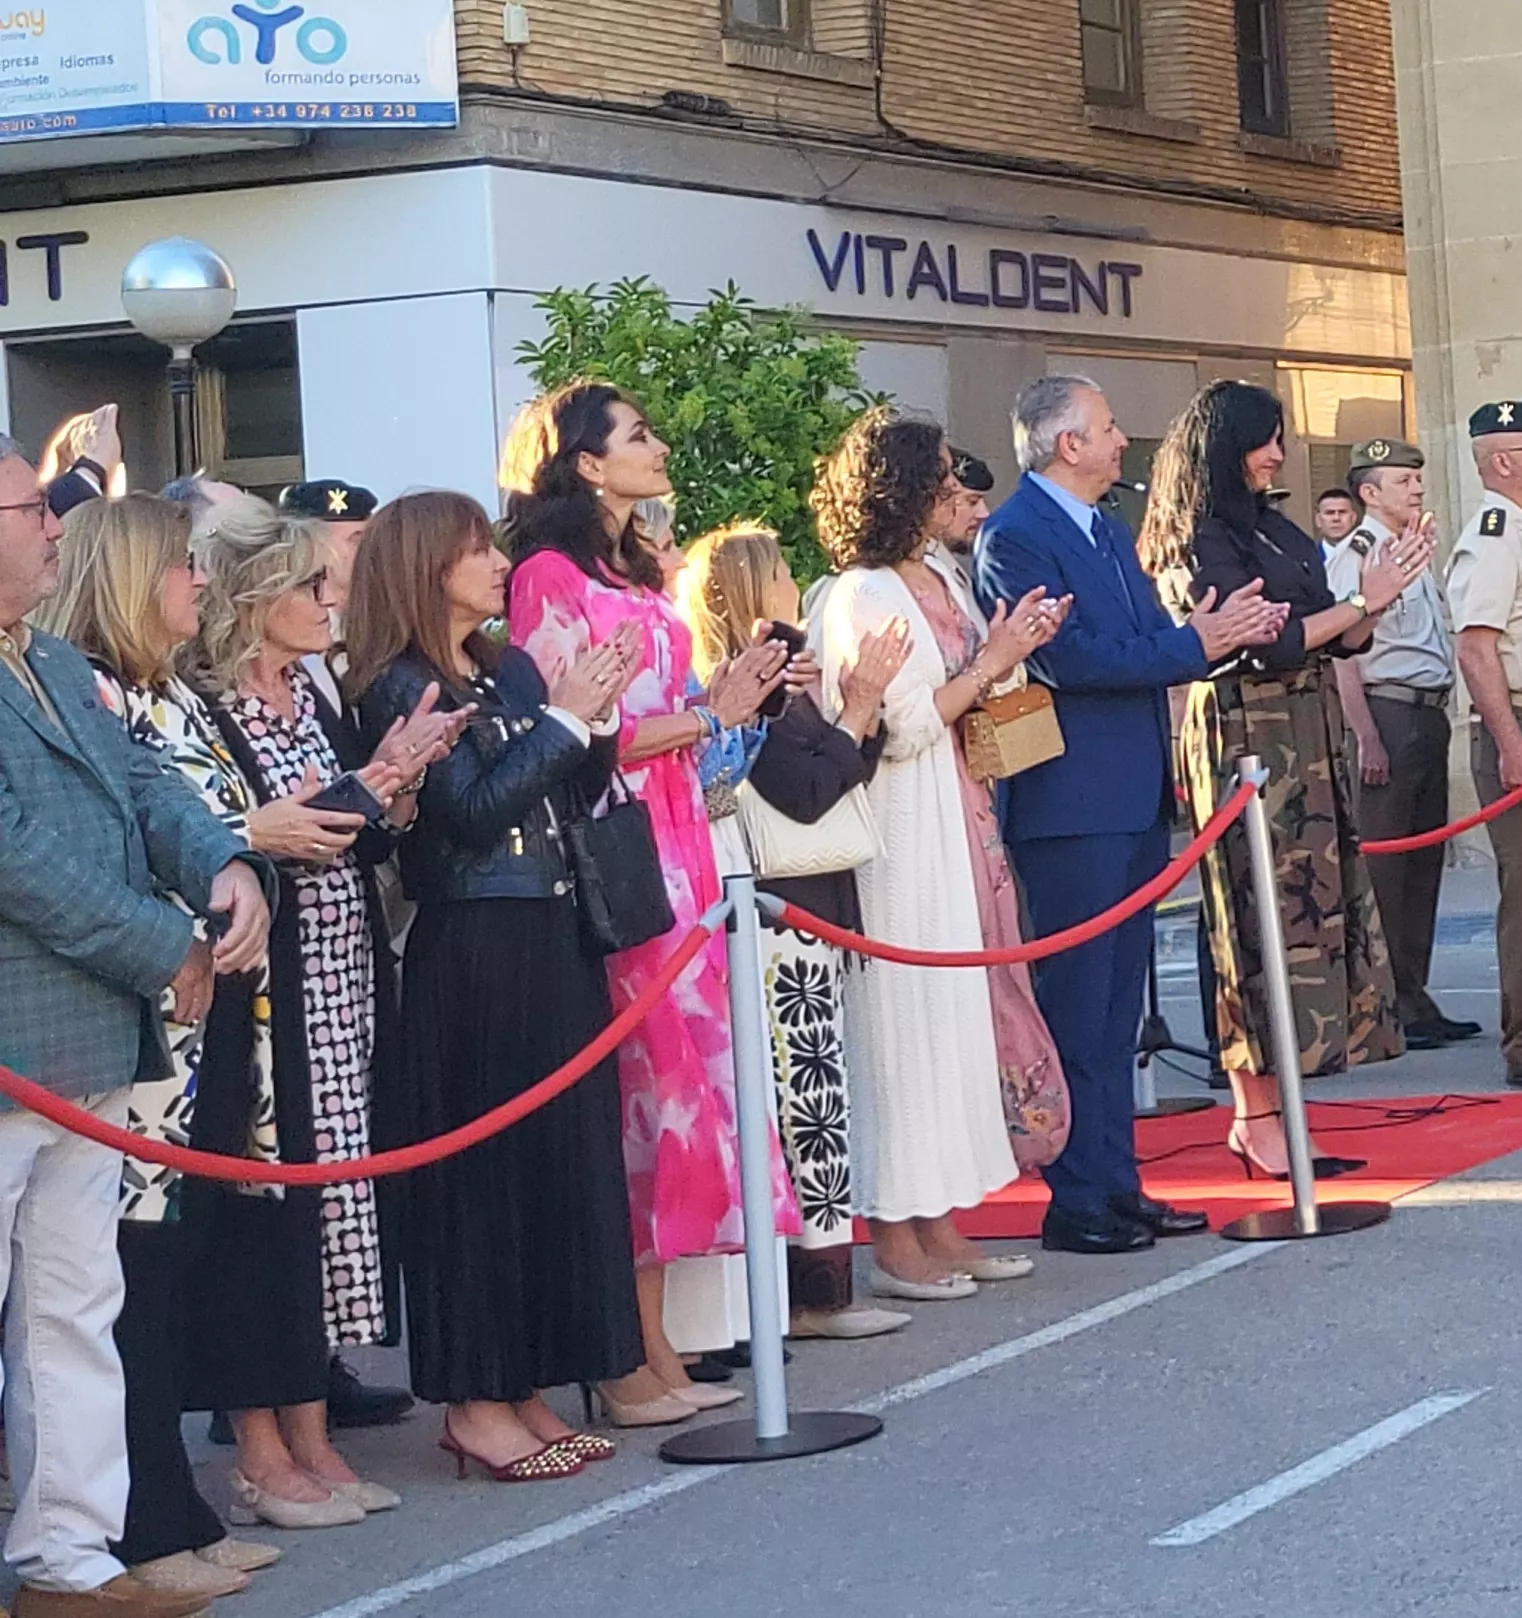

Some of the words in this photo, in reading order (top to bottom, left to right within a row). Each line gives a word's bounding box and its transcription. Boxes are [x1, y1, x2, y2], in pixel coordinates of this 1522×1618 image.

[0, 55, 39, 71] presa
[60, 54, 114, 69] Idiomas
[264, 69, 345, 85] formando
[349, 71, 421, 87] personas
[252, 105, 288, 118] +34
[296, 104, 331, 118] 974
[806, 228, 1143, 317] VITALDENT
